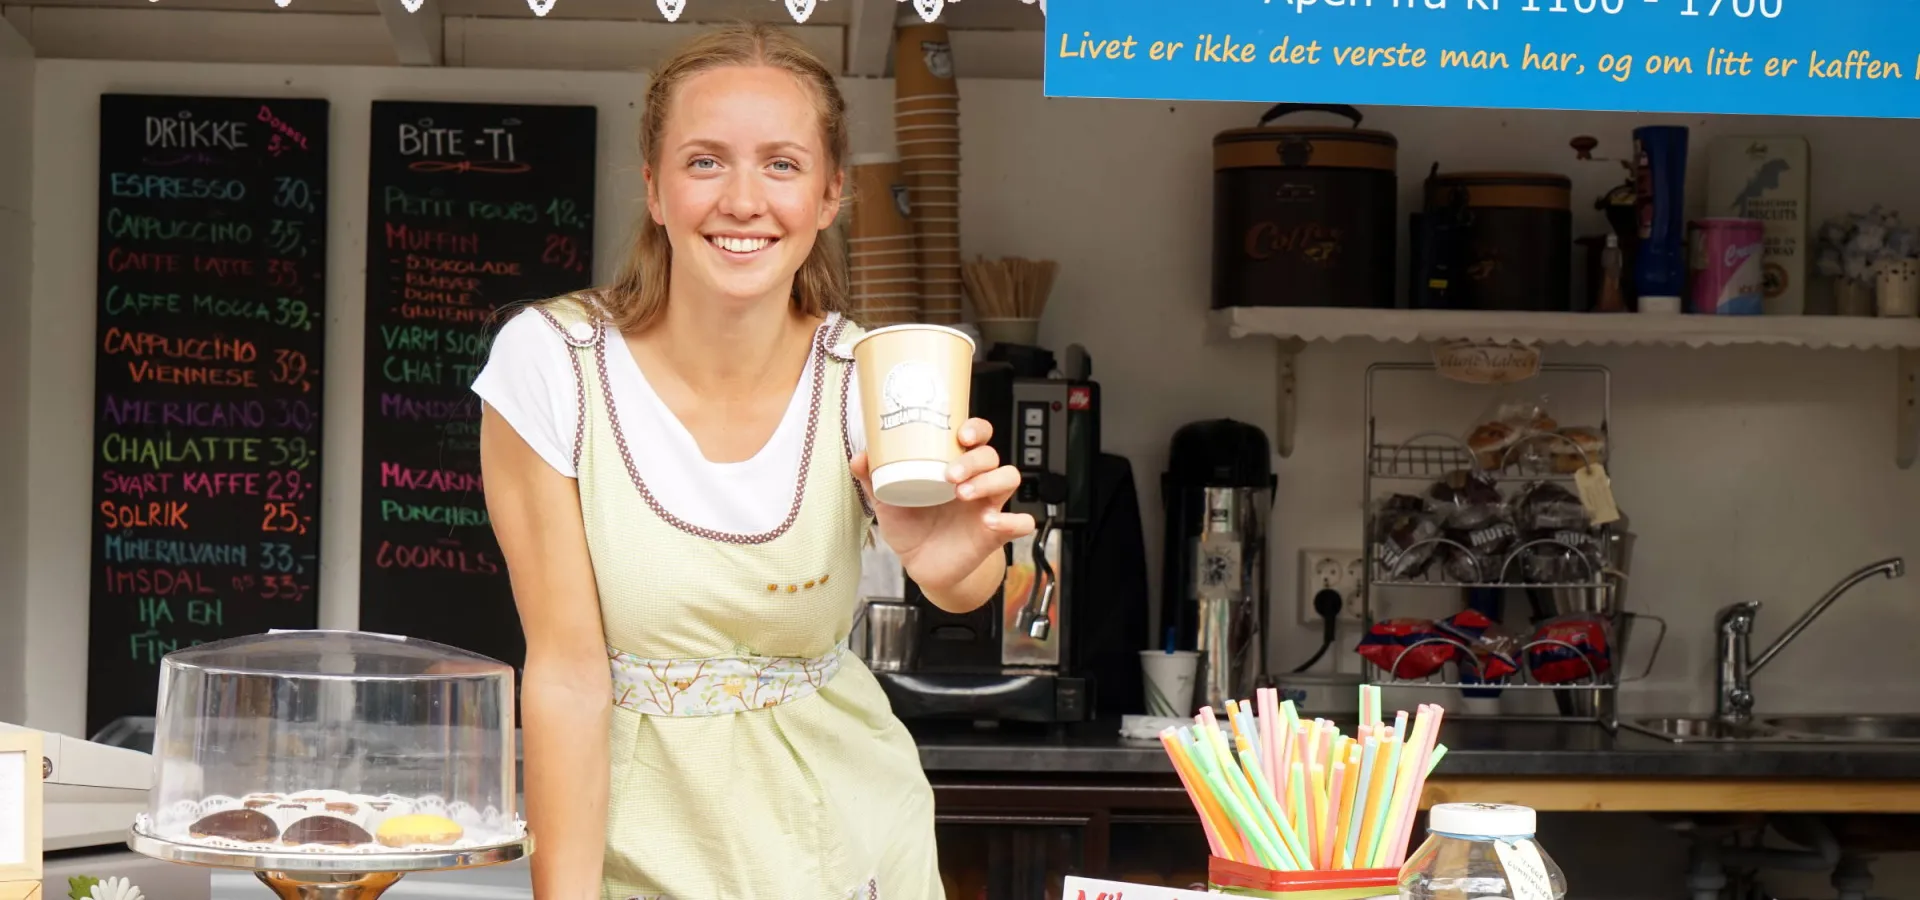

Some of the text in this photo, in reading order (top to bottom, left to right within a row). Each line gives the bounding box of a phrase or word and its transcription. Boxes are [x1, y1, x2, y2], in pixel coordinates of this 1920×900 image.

[1059, 31, 1137, 59] Livet
[1149, 40, 1183, 61] er
[1195, 34, 1256, 63] ikke
[1269, 35, 1322, 64] det
[1333, 43, 1427, 68] verste
[1440, 48, 1510, 70] man
[1522, 43, 1585, 75] har,
[1598, 52, 1633, 83] og
[1645, 55, 1693, 75] om
[1706, 47, 1753, 76] litt
[1764, 57, 1798, 77] er
[1808, 49, 1903, 80] kaffen
[110, 172, 246, 200] ESPRESSO
[107, 207, 252, 244] CAPPUCCINO
[384, 221, 480, 254] MUFFIN
[105, 284, 181, 317] CAFFE
[193, 294, 271, 323] MOCCA
[104, 326, 257, 363] CAPPUCCINO
[380, 324, 440, 353] VARM
[128, 360, 258, 389] VIENNESE
[102, 394, 266, 430] AMERICANO
[102, 469, 174, 501] SVART
[183, 471, 260, 499] KAFFE
[100, 500, 189, 530] SOLRIK
[105, 531, 247, 567] MINERALVANN
[105, 566, 216, 596] IMSDAL
[138, 597, 223, 629] HA EN
